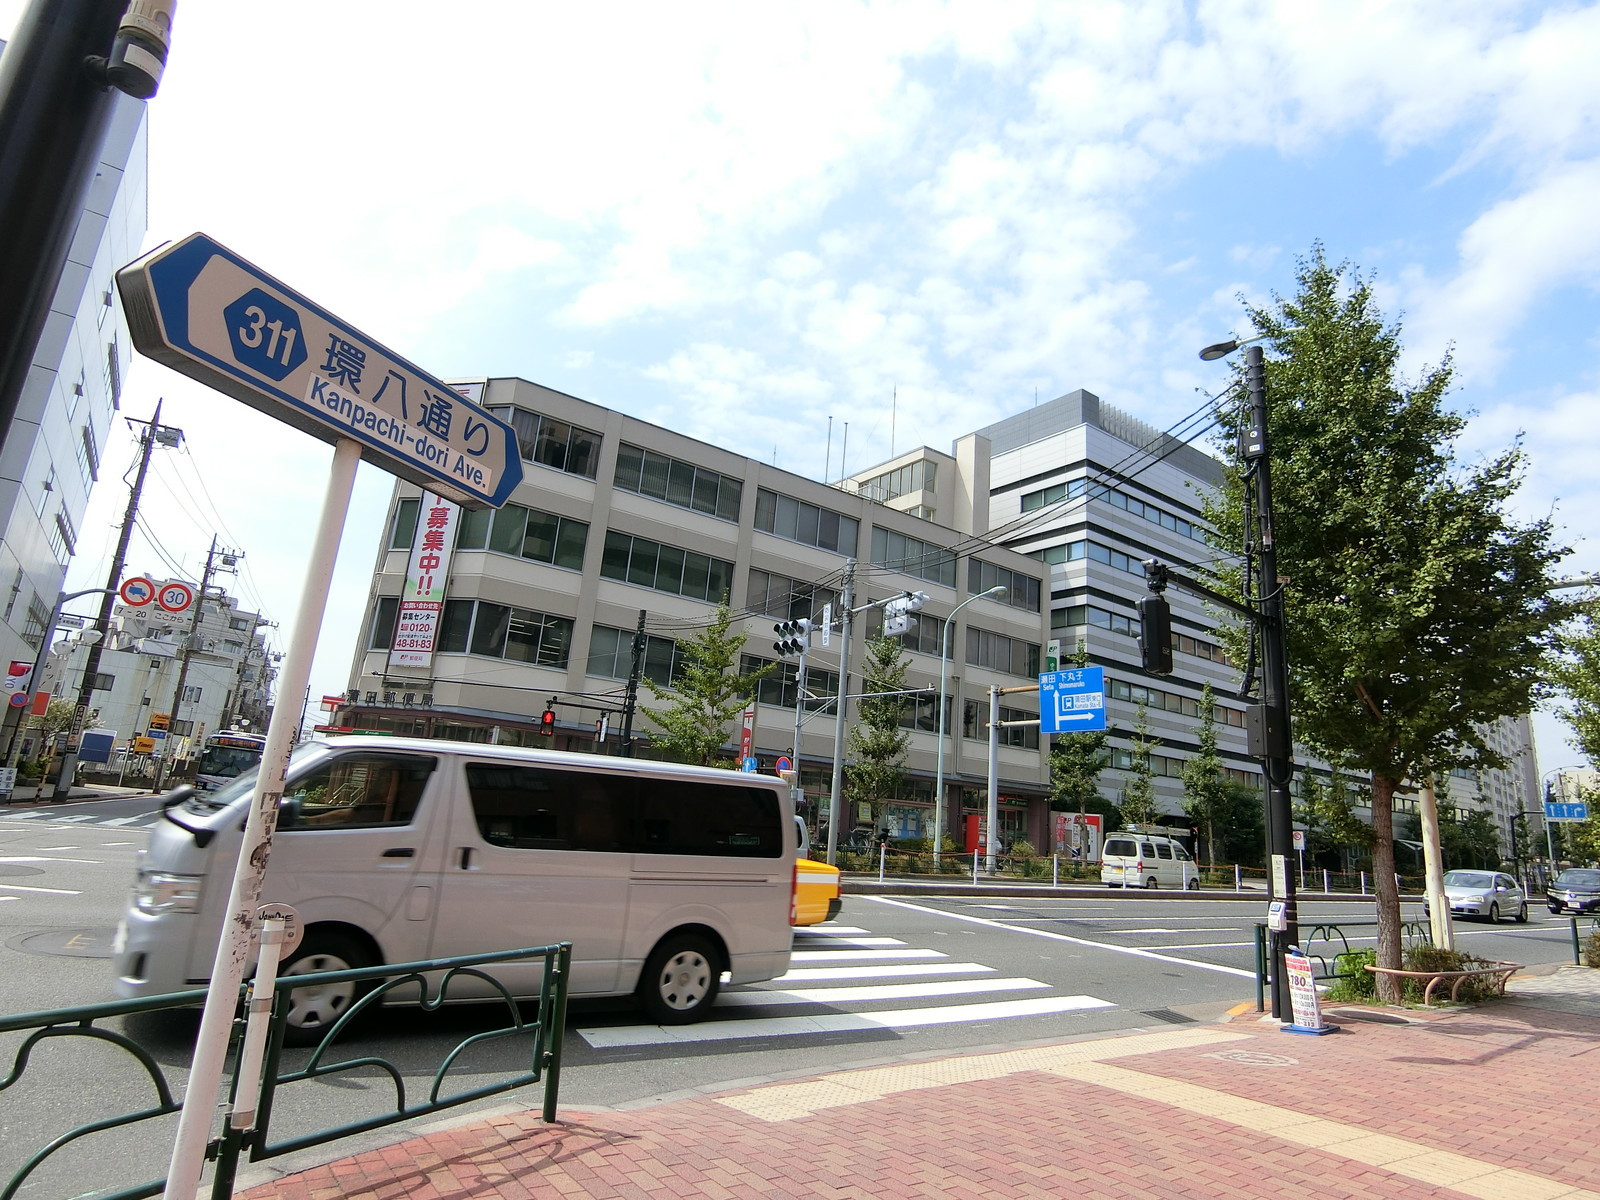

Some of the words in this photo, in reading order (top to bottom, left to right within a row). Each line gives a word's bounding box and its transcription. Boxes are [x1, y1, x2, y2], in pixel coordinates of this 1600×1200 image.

[239, 305, 297, 367] 311
[319, 333, 490, 456] 環八通り
[310, 377, 449, 468] Kanpachi-dori
[453, 457, 487, 488] Ave.
[165, 591, 185, 605] 30
[155, 613, 184, 623] ここから
[402, 612, 436, 621] 募集センター
[396, 639, 432, 648] 48-81-83
[1059, 671, 1083, 682] 下丸子
[346, 689, 434, 707] 蒲田郵便局
